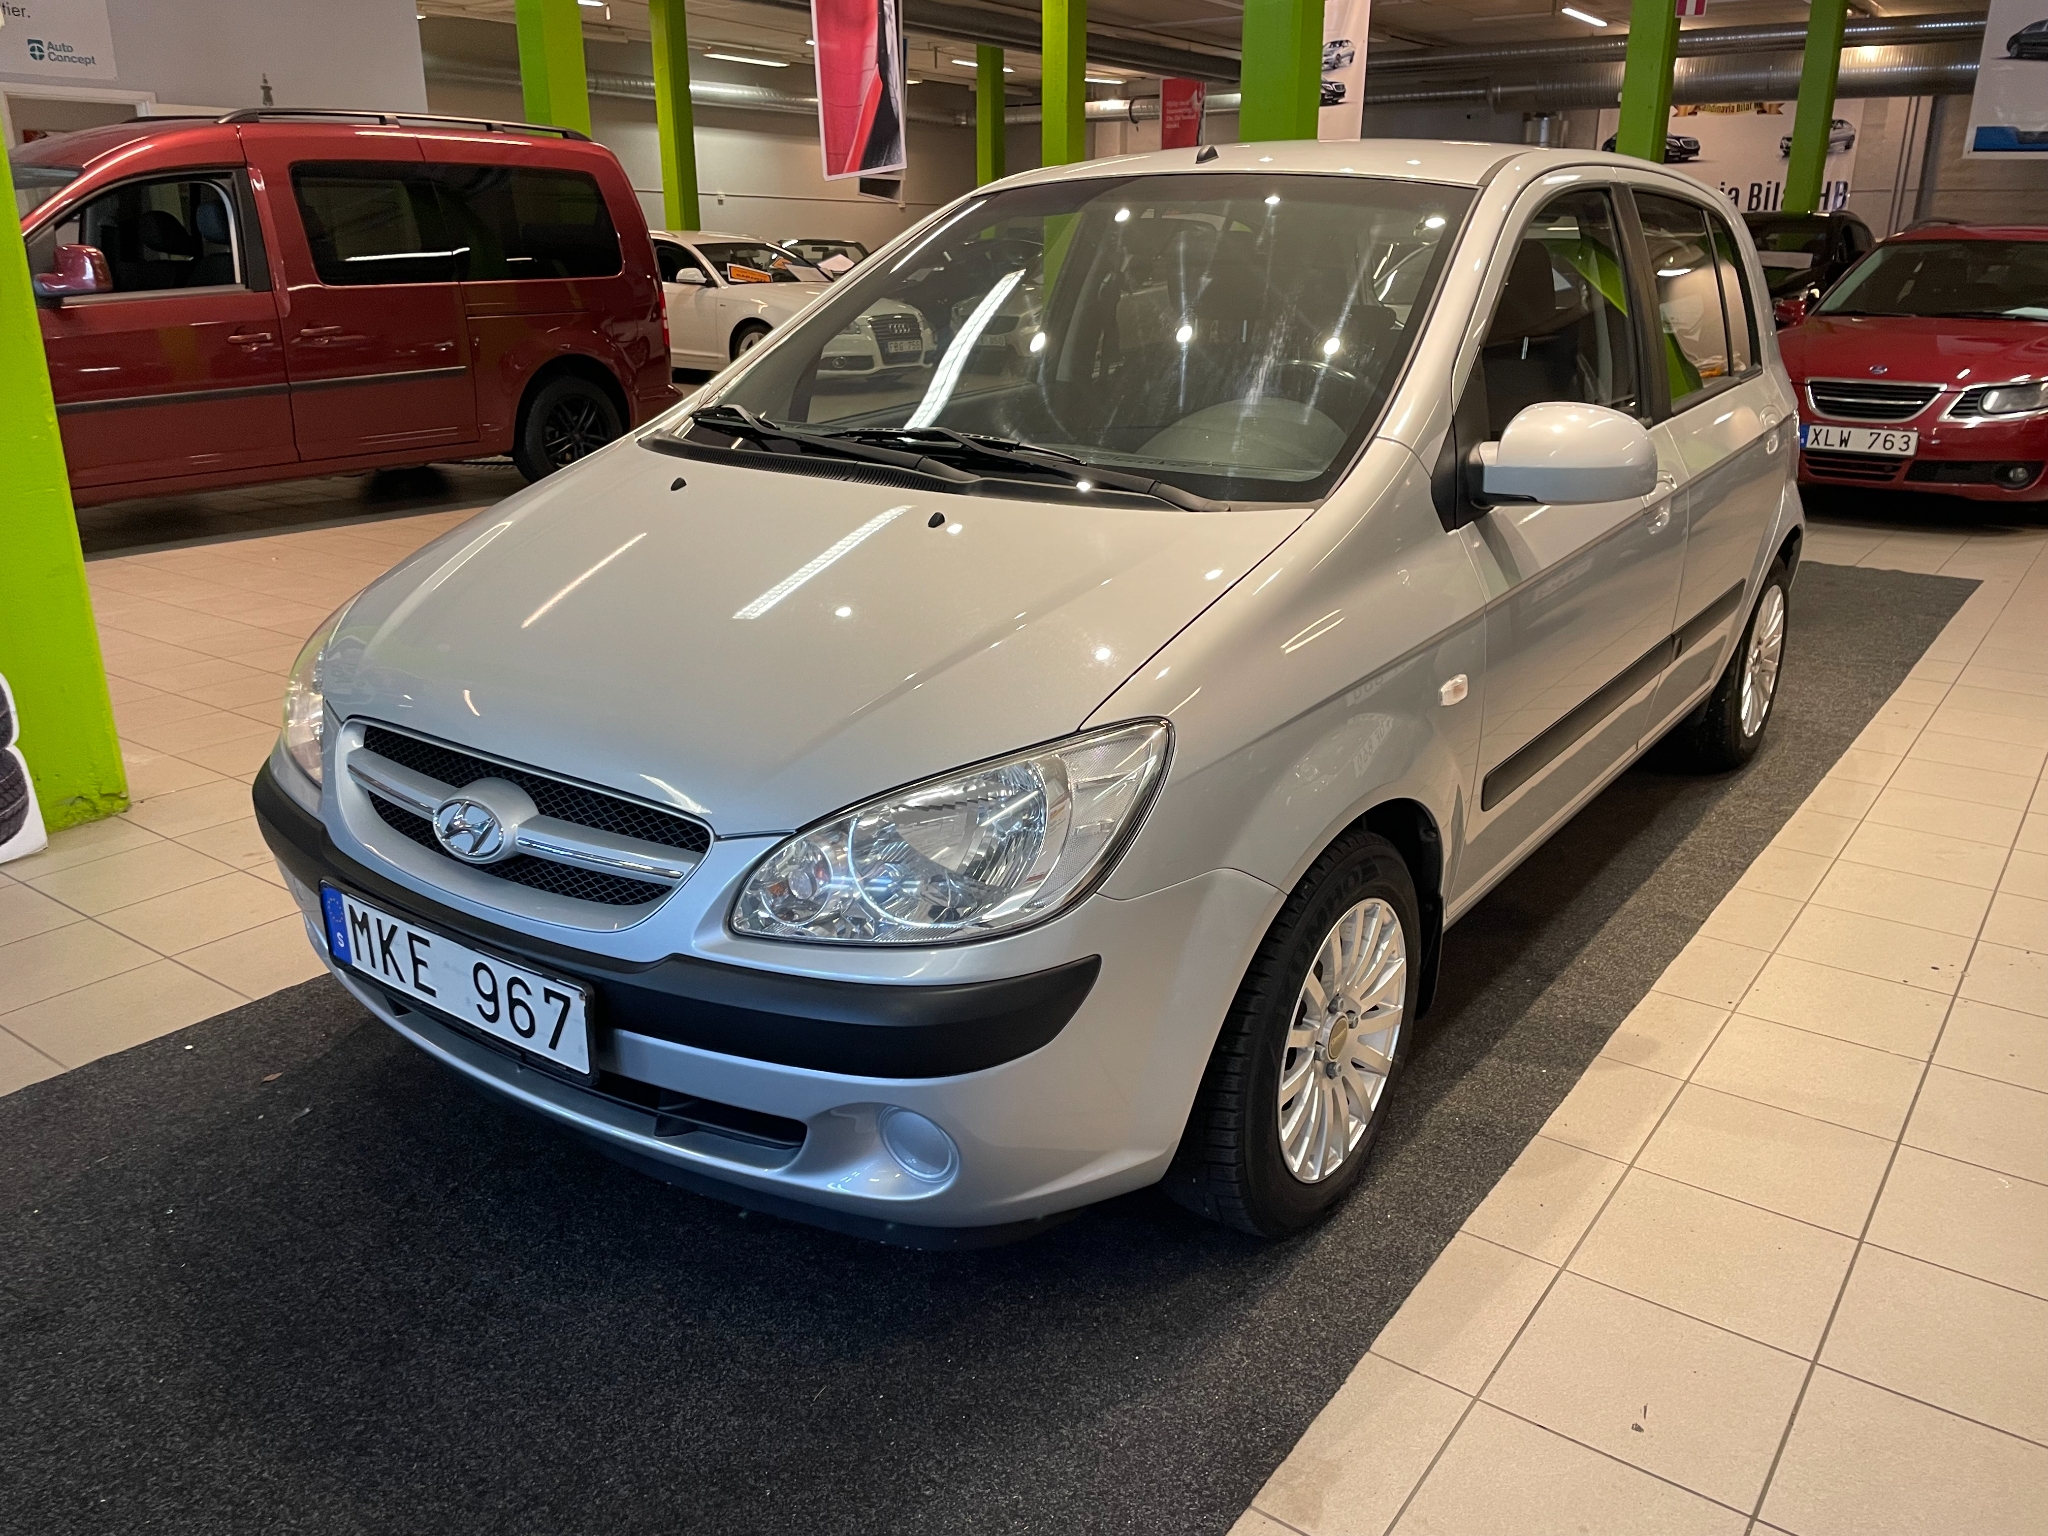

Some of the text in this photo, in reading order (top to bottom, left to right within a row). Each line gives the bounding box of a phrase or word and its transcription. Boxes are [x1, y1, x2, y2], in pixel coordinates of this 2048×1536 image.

[47, 41, 73, 53] Auto
[47, 52, 97, 66] Concept
[1810, 428, 1912, 452] XLW 763
[336, 931, 345, 948] S
[347, 903, 571, 1051] MKE 967
